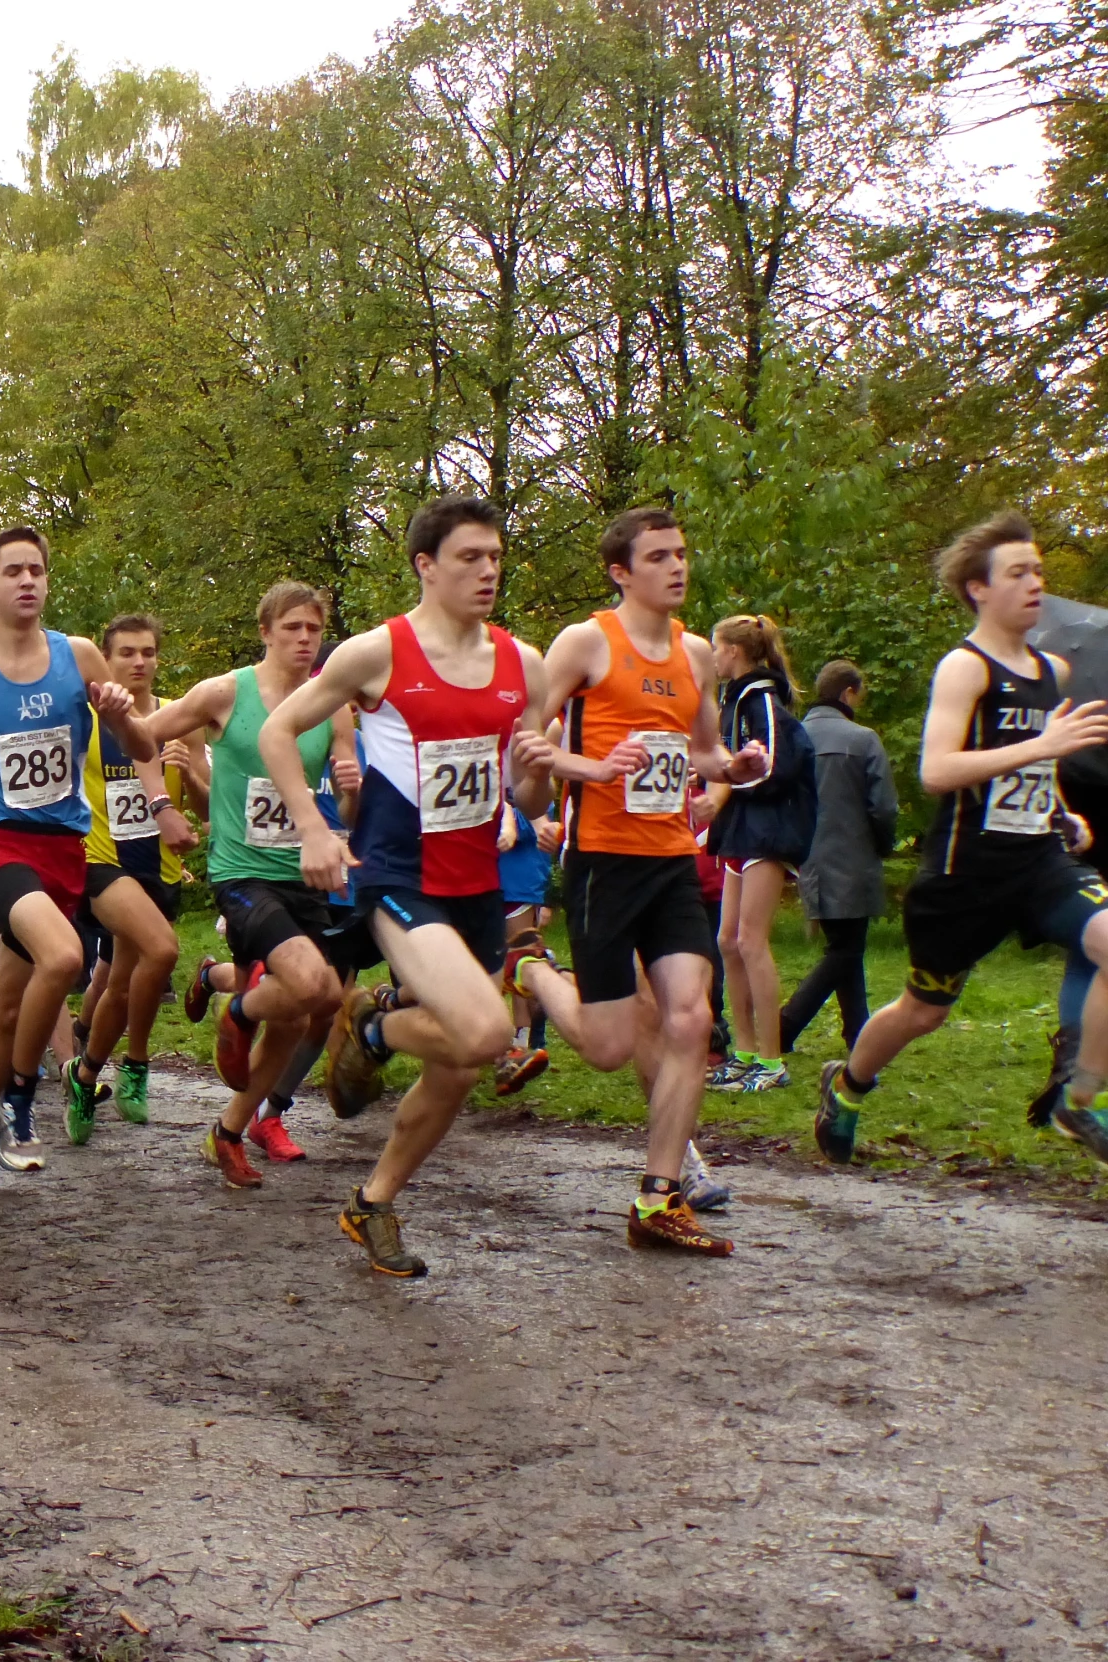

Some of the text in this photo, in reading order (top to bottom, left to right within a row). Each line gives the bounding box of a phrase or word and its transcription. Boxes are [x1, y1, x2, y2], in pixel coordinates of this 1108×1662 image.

[641, 678, 676, 697] ASL
[997, 707, 1050, 730] ZU
[27, 732, 42, 740] ISST
[5, 745, 67, 791] 283
[434, 760, 490, 809] 241
[631, 752, 685, 793] 239
[115, 793, 149, 825] 23
[252, 796, 296, 830] 24
